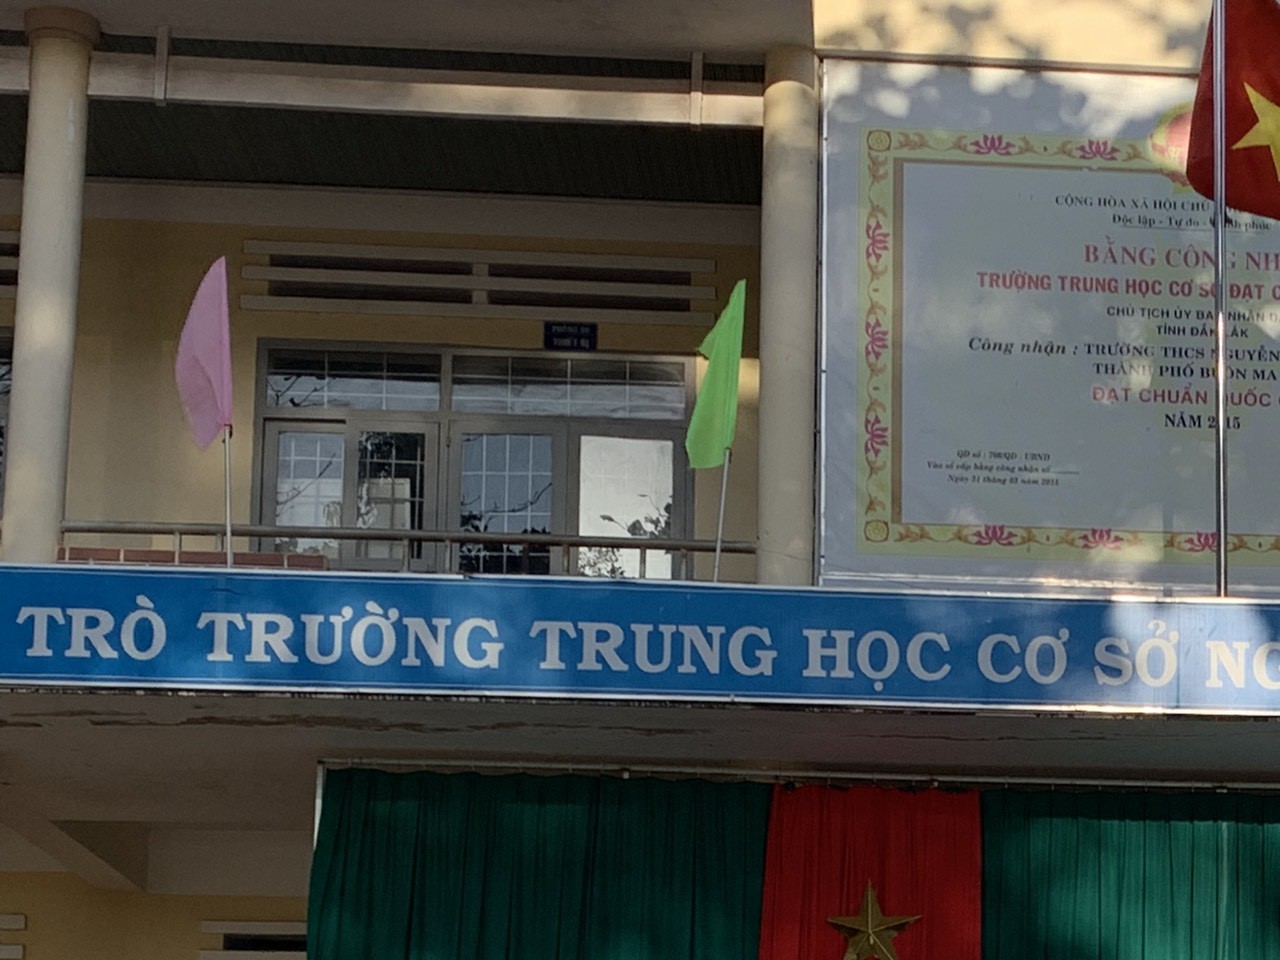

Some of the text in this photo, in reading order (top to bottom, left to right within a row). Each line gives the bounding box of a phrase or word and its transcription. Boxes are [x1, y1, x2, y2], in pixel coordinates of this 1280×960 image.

[1055, 194, 1094, 207] CỘNG
[1098, 195, 1126, 208] HÒA
[1152, 198, 1177, 212] HỘI
[1112, 212, 1134, 226] Độc
[1138, 213, 1156, 227] lập
[1167, 215, 1183, 229] Tự
[1084, 235, 1156, 267] BẰNG
[976, 268, 1051, 292] TRƯỜNG
[1058, 275, 1119, 294] TRUNG
[1125, 278, 1162, 298] HỌC
[1168, 278, 1194, 298] CƠ
[1229, 284, 1265, 304] ĐẠT
[1106, 303, 1136, 317] CHỦ
[1141, 307, 1171, 320] TỊCH
[1228, 308, 1267, 323] NHÂN
[968, 336, 1014, 356] Công
[1020, 338, 1066, 357] nhận
[1083, 341, 1155, 358] TRƯỜNG
[1160, 347, 1205, 359] THCS
[1092, 360, 1151, 376] THÀNH
[1159, 360, 1194, 378] PHỐ
[1252, 369, 1277, 381] MA
[1092, 386, 1131, 406] ĐẠT
[1138, 382, 1208, 406] CHUẨN
[1164, 411, 1241, 431] NĂM 215
[17, 595, 168, 661] TRÒ
[197, 601, 504, 670] TRƯỜNG
[530, 619, 778, 677] TRUNG
[802, 628, 952, 692] HỌC
[977, 629, 1070, 685] CƠ
[1093, 619, 1180, 688] SỞ
